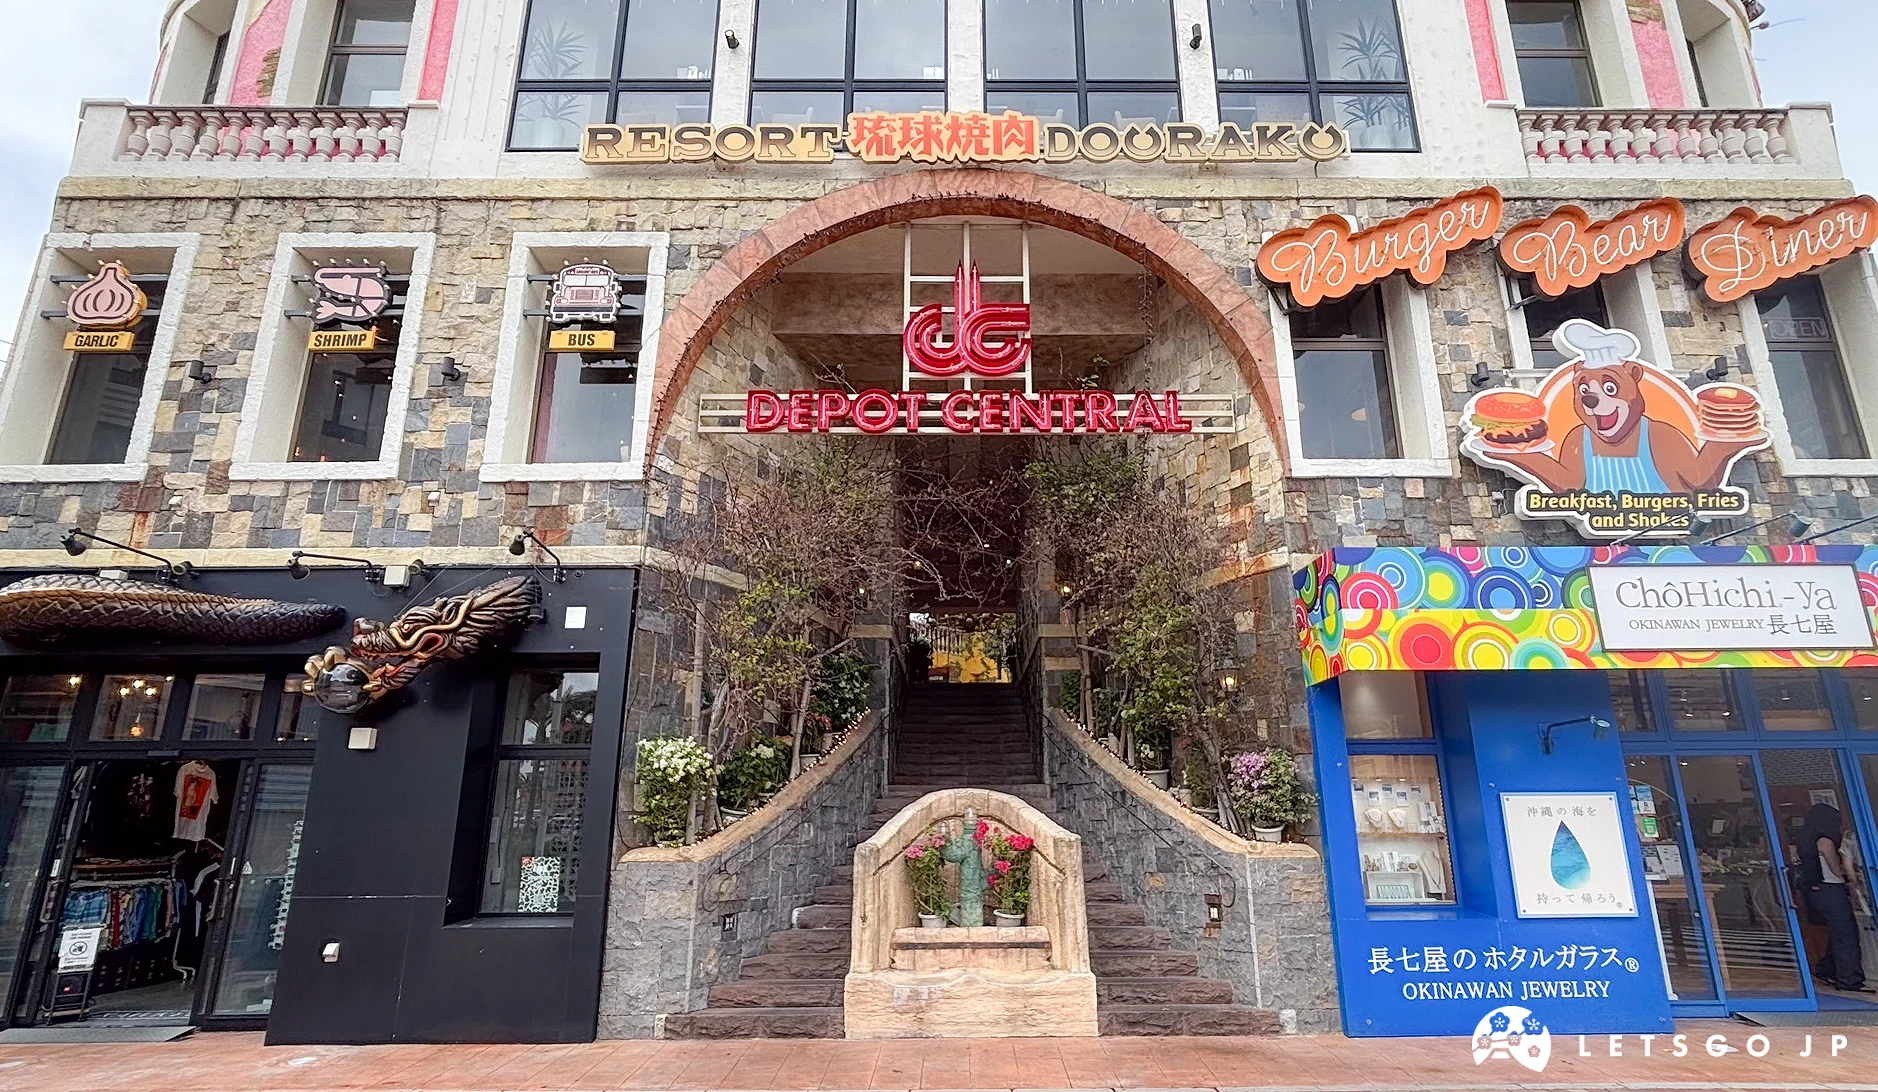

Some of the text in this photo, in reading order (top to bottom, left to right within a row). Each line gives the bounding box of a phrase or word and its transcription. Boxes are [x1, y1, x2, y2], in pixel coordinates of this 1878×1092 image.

[585, 114, 1344, 159] RESORT 琉球焼肉 DOURAKU
[1271, 200, 1868, 293] Burger Bear Diner
[1769, 319, 1826, 337] OPEN
[74, 335, 119, 347] GARLIC
[314, 333, 367, 347] SHRIMP
[568, 333, 596, 346] BUS
[745, 389, 1193, 434] DEPOT CENTRAL
[1529, 493, 1739, 511] Breakfast, Burgers, Fries
[1592, 512, 1689, 528] and Shakes
[1629, 614, 1838, 635] OKINAWAN JEWELRY 長七屋
[1527, 806, 1597, 817] 沖縄の海を
[1402, 980, 1611, 1000] OKINAWAN JEWELRY
